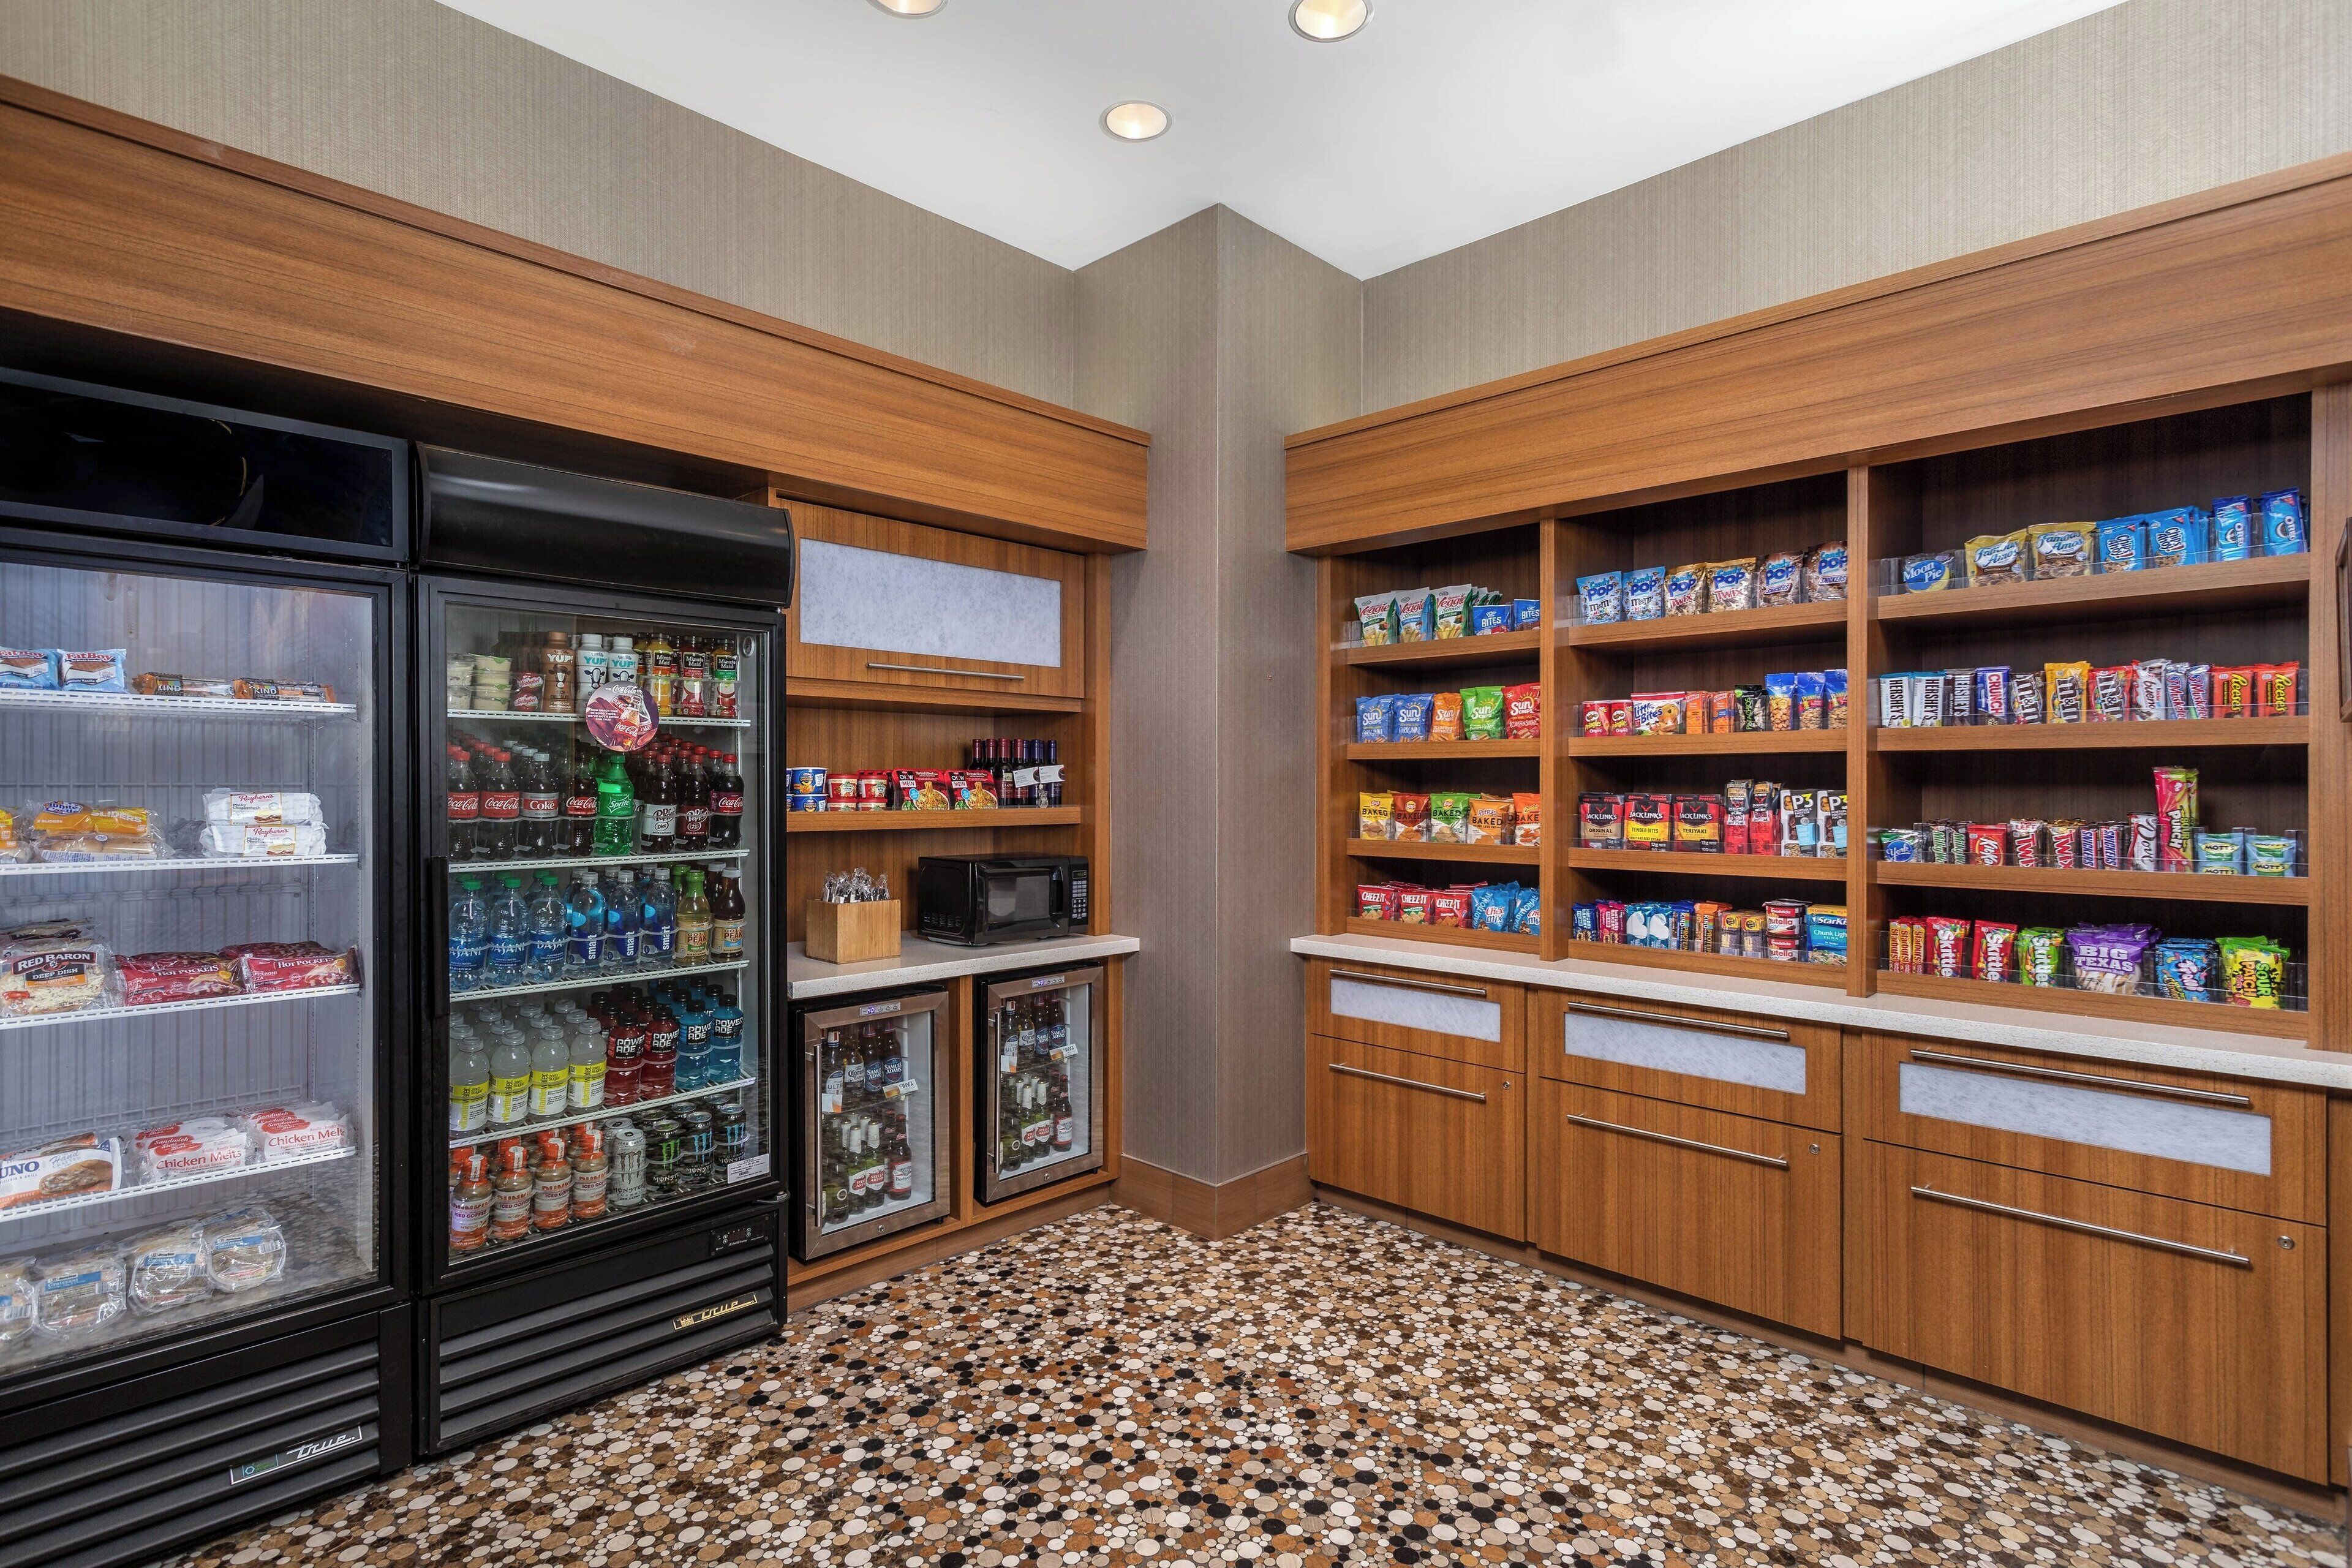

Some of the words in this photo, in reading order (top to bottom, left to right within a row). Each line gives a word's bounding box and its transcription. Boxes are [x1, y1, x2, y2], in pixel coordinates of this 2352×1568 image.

[2234, 521, 2244, 547] OREO
[2284, 515, 2296, 541] OREO
[2051, 540, 2084, 551] Amos
[1902, 561, 1935, 581] Moon
[1924, 567, 1942, 582] Pie
[1521, 609, 1540, 619] BITES
[1482, 617, 1501, 628] BITES
[66, 652, 113, 662] FatBoy
[547, 654, 574, 663] YUP!
[584, 656, 608, 666] YUP!
[612, 660, 636, 668] YUP!
[521, 678, 540, 687] Babybel
[612, 685, 638, 694] Coca-Cola
[517, 696, 537, 705] Babybel
[1987, 673, 2003, 717] CRUNCH
[2144, 680, 2154, 709] bueno
[1399, 709, 1419, 722] Sun
[1634, 703, 1654, 719] Little
[1641, 709, 1663, 724] Bites
[1362, 712, 1379, 726] Sun
[614, 723, 638, 737] Coca-Cola
[49, 802, 78, 810] White
[238, 794, 274, 804] Raybern's
[484, 797, 519, 810] Coca-Cola
[529, 800, 555, 810] Coke
[609, 799, 631, 809] Sprite
[1792, 793, 1814, 810] P3
[91, 811, 142, 823] SLIDERS
[1472, 816, 1502, 826] BAKED
[253, 827, 288, 837] Raybern's
[2168, 809, 2182, 849] PUNCH
[1887, 843, 1912, 861] York
[2082, 829, 2094, 867] SNICKERS
[2103, 828, 2117, 867] SNICKERS
[1486, 907, 1505, 916] Chex
[627, 930, 635, 956] smart
[662, 925, 671, 951] smart
[588, 934, 597, 960] smart
[1938, 929, 1955, 977] Skittle
[2079, 946, 2128, 960] BIG
[18, 957, 44, 971] RED
[45, 953, 91, 962] BARON
[296, 957, 334, 967] POCKETS
[2033, 937, 2049, 987] Skittles
[2074, 957, 2134, 972] TEXAS
[178, 965, 219, 974] POCKETS
[2239, 960, 2257, 998] PATCH
[2255, 963, 2271, 996] SOUR
[715, 1019, 743, 1027] POWER
[268, 1134, 315, 1147] Chicken
[50, 1150, 80, 1164] Hand
[156, 1156, 206, 1169] Chicken
[210, 1150, 242, 1163] Melts
